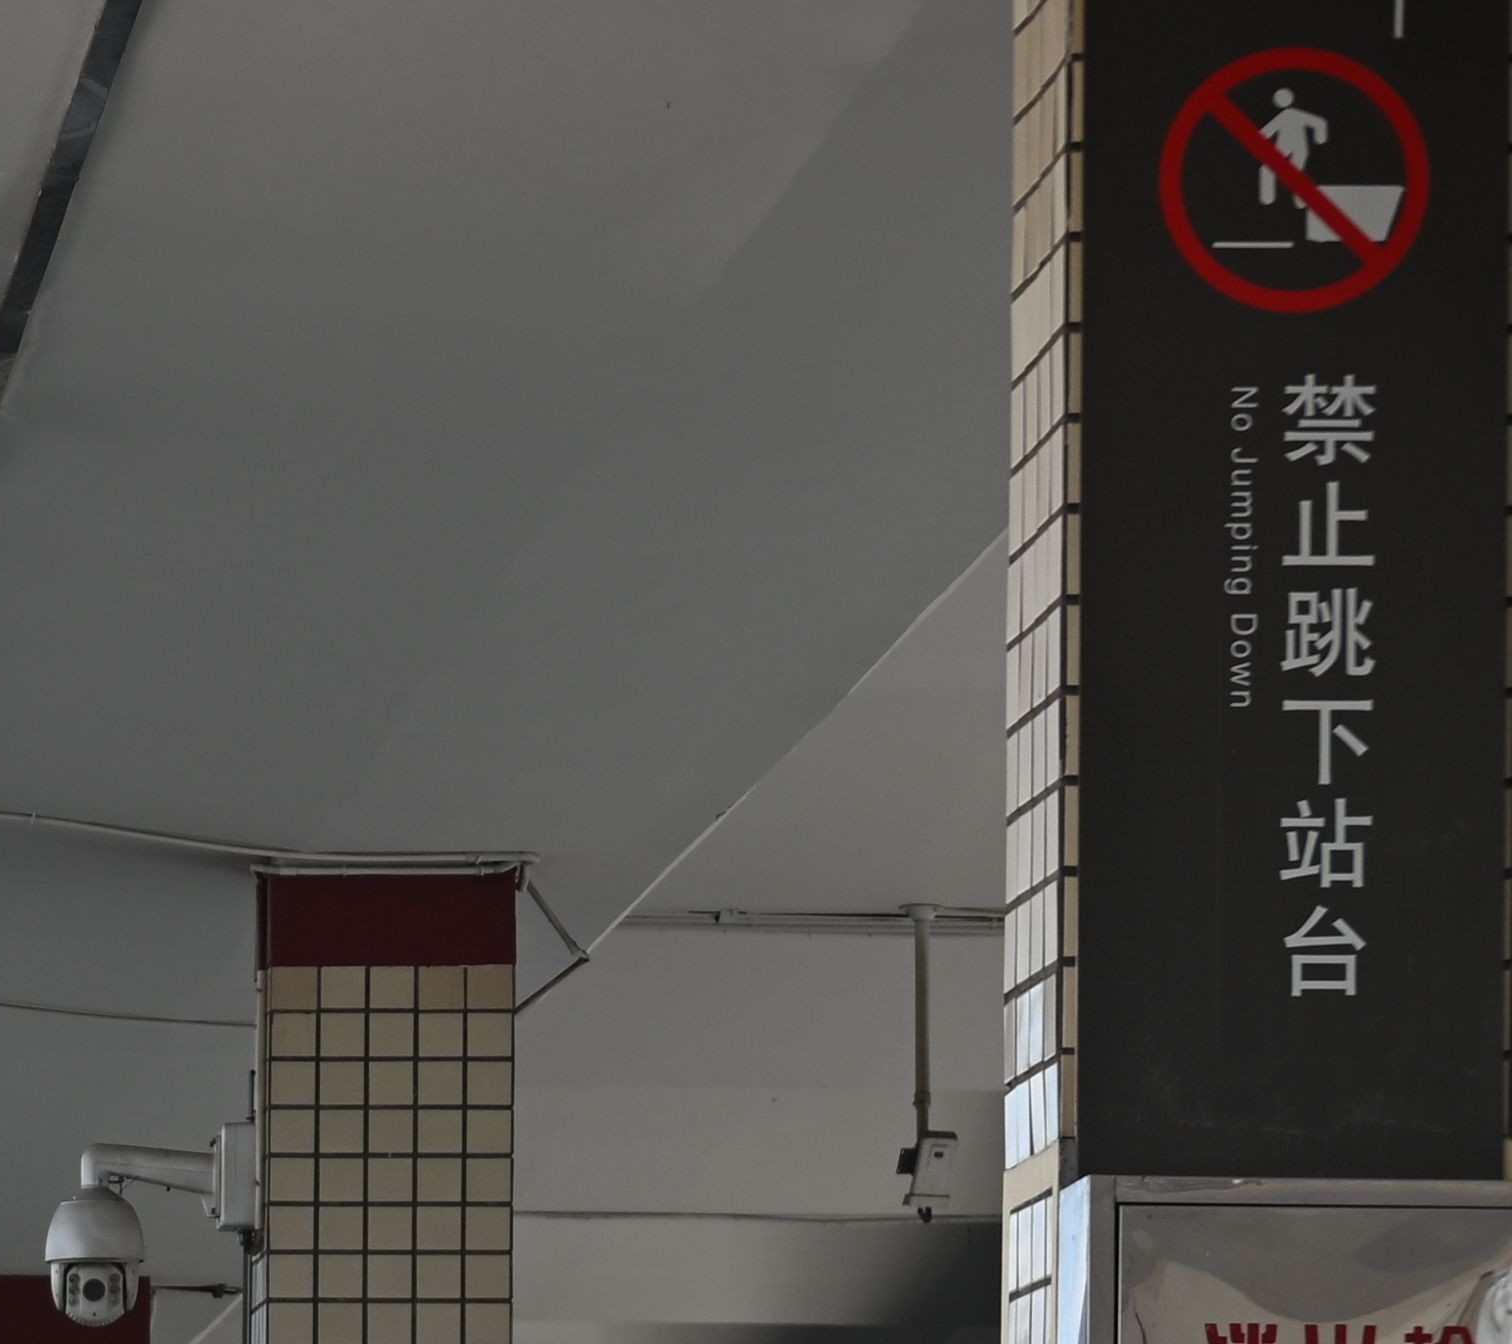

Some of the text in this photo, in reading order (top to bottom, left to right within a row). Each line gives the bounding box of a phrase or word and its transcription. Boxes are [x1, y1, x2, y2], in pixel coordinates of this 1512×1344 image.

[1224, 386, 1258, 709] No Jumping Down
[1279, 373, 1377, 996] 禁止跳下站台
